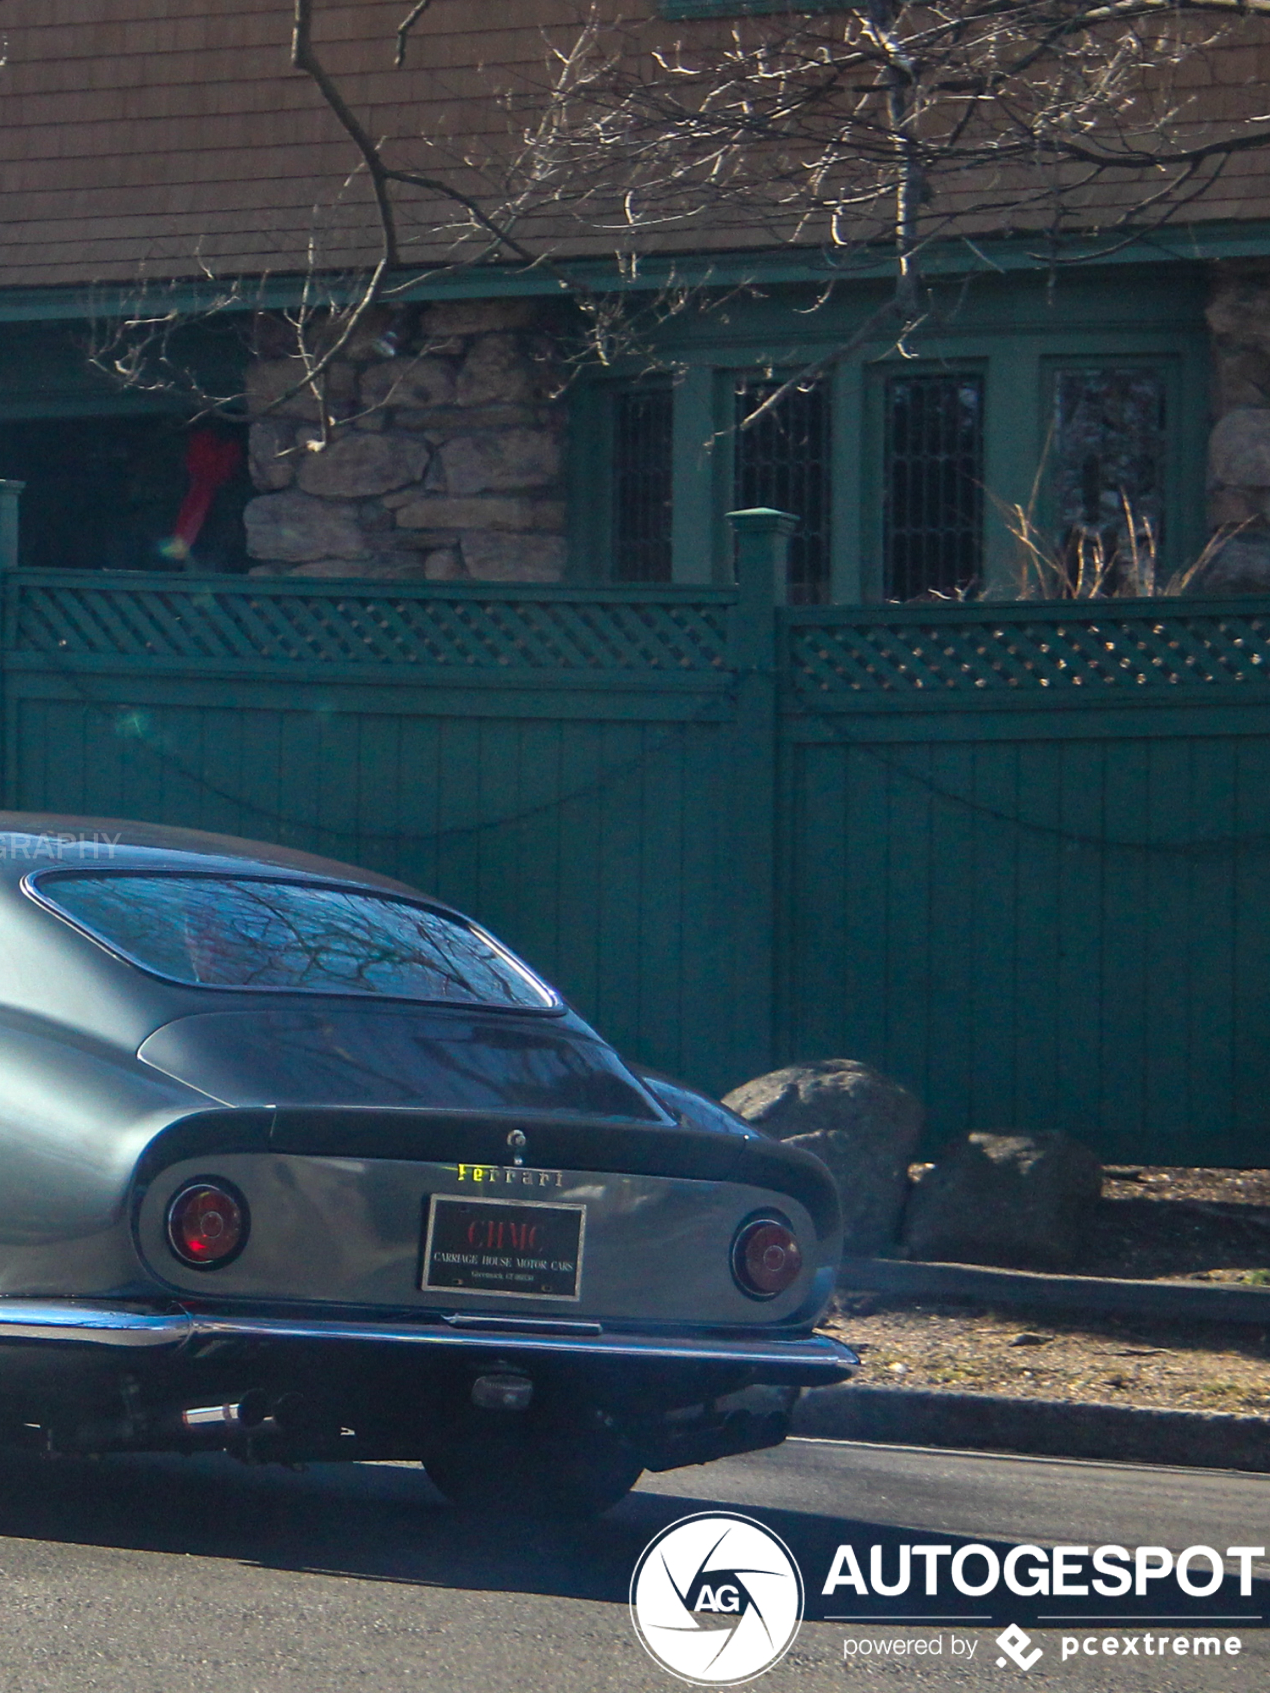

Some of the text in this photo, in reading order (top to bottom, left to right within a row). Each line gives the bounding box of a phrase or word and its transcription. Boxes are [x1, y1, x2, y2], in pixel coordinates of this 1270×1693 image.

[467, 1219, 543, 1253] CHMC
[433, 1252, 574, 1272] CARRIAGE HOUSE MOTOR CARS
